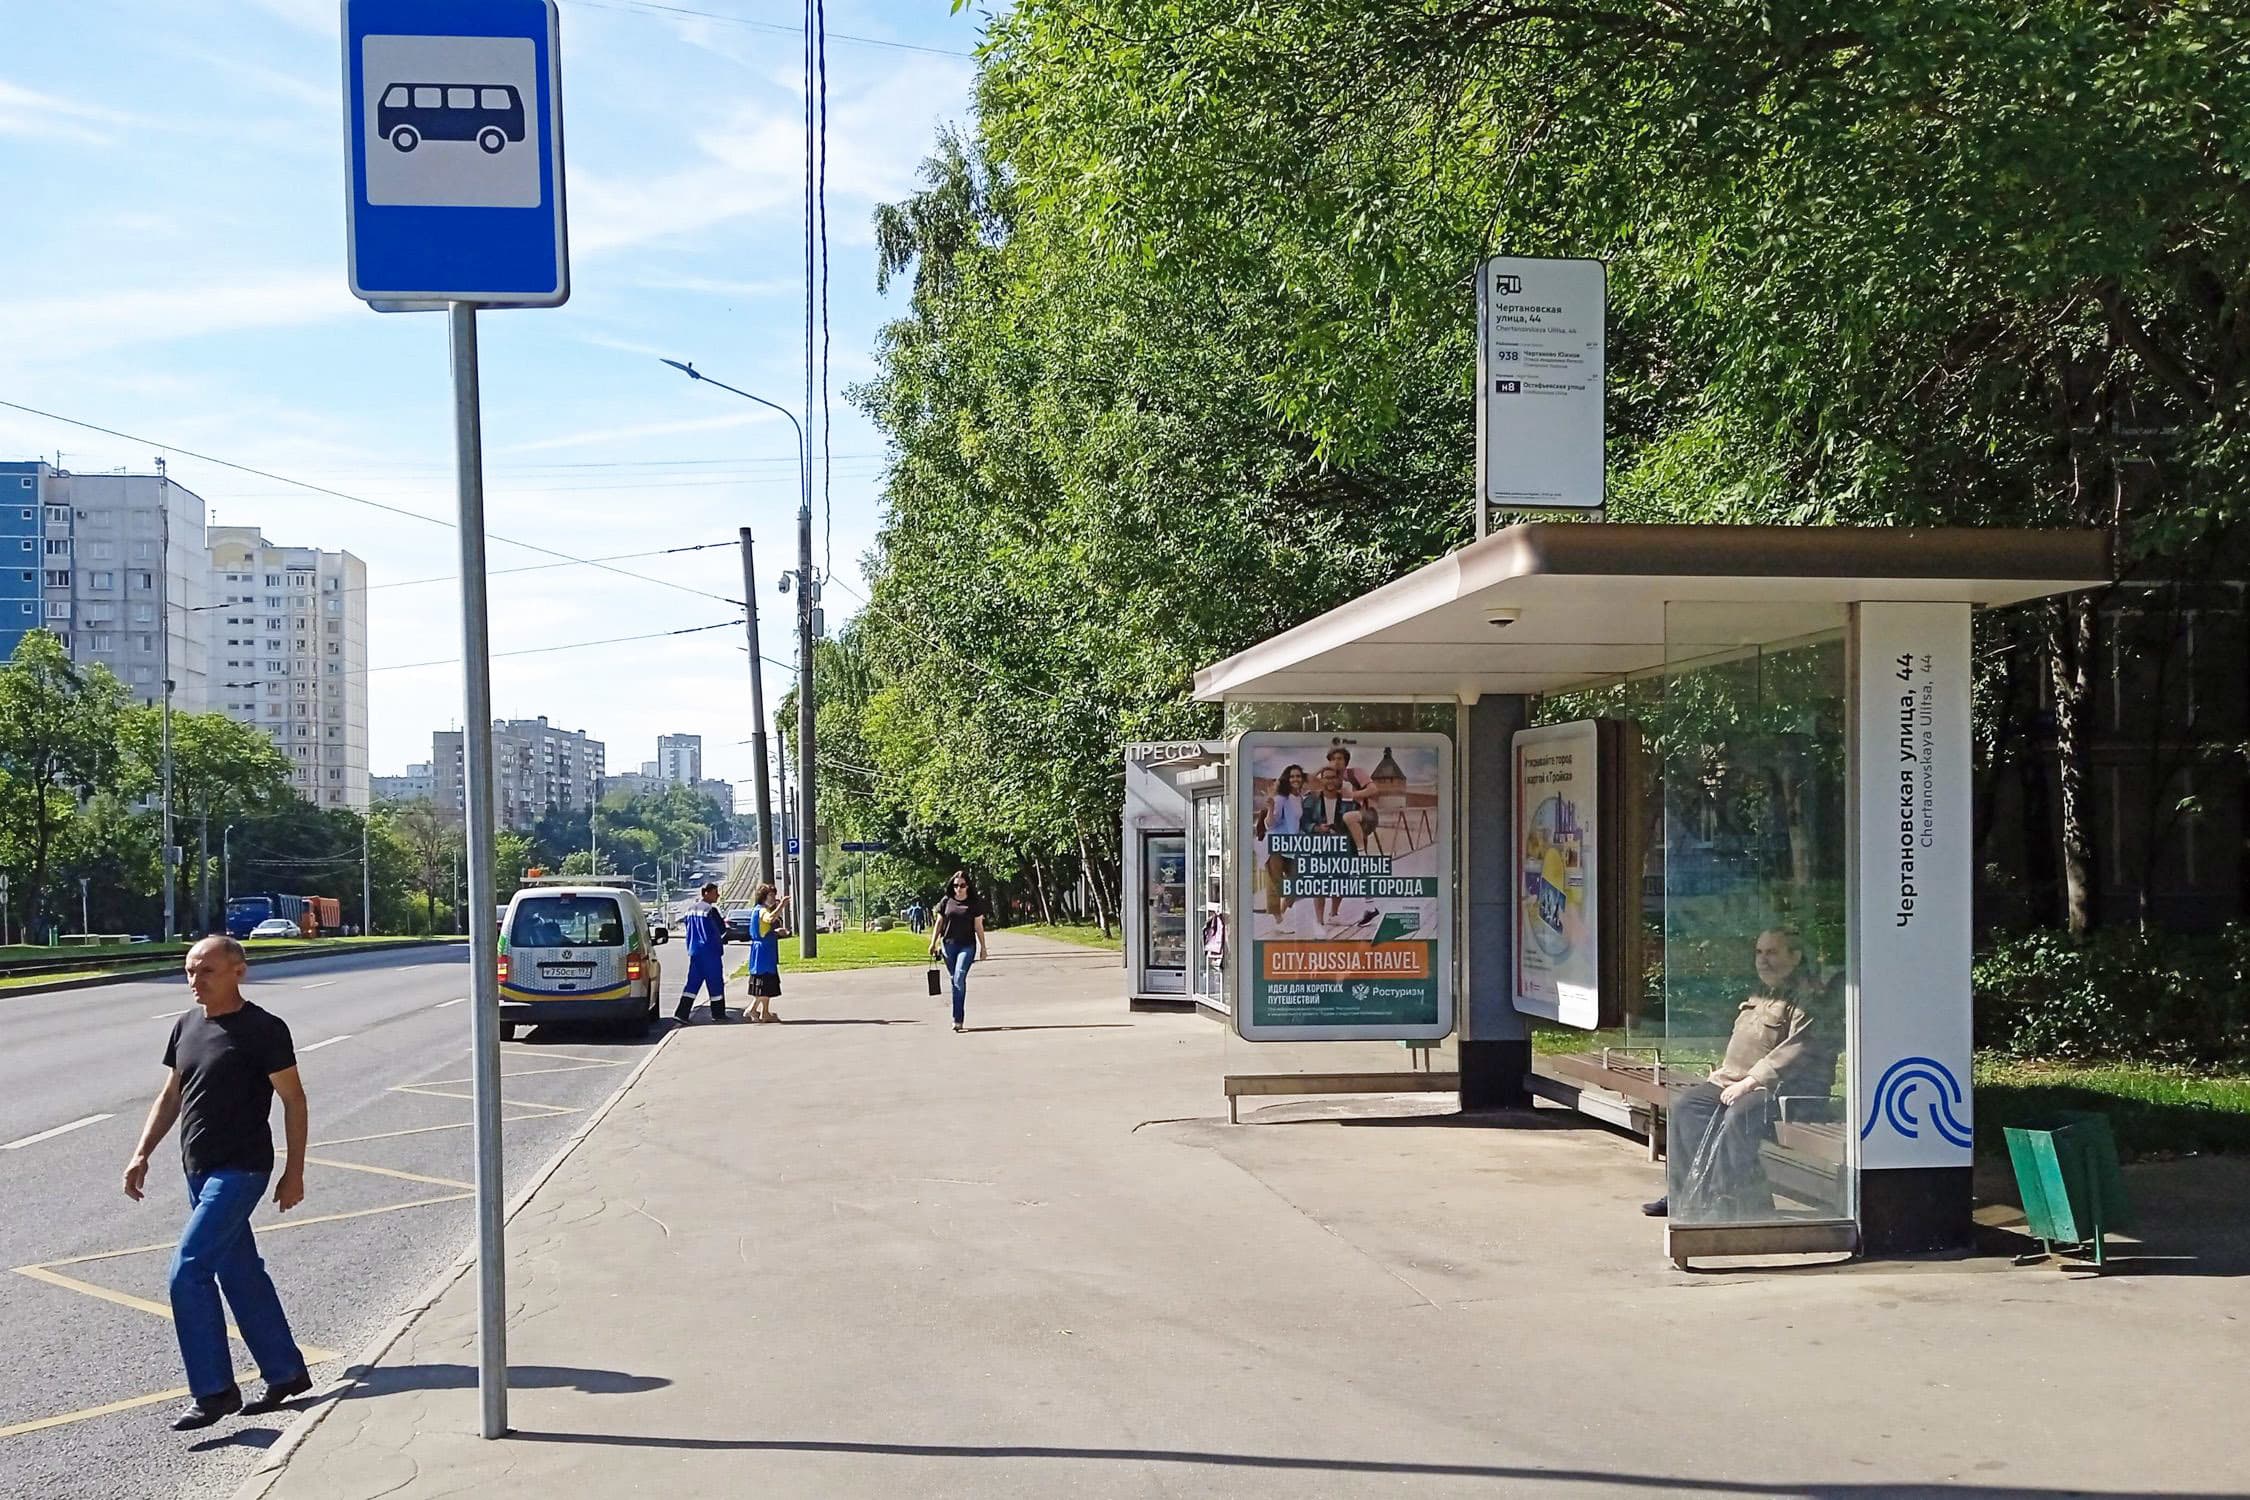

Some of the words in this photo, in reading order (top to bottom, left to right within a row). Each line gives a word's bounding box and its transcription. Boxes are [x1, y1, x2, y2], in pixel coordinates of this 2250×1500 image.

[1496, 303, 1562, 314] Чертановская
[1496, 314, 1527, 324] улица,
[1529, 314, 1541, 323] 44
[1499, 351, 1519, 361] 938
[1896, 653, 1914, 682] 44
[1920, 653, 1932, 673] 44
[1920, 681, 1934, 726] Ulitsa,
[1900, 689, 1917, 761] улица,
[1127, 743, 1201, 761] ПРЕССА
[1920, 732, 1933, 849] Chertanovskaya
[1272, 835, 1347, 853] ВЫХОДИТЕ
[1896, 770, 1917, 927] Чертановская
[1297, 857, 1306, 874] В
[1310, 857, 1390, 875] ВЫХОДНЫЕ
[1283, 879, 1291, 896] В
[1295, 879, 1366, 897] СОСЕДНИЕ
[1370, 879, 1423, 897] ГОРОДА
[1272, 951, 1420, 970] CITY.RUSSIA.TRAVEL
[1268, 984, 1288, 995] ИДЕИ
[1289, 984, 1305, 994] ДЛЯ
[1306, 984, 1344, 993] КОРОТКИХ
[1372, 987, 1425, 998] Ростуризм
[1267, 994, 1320, 1005] ПУТЕШЕСТВИЙ
